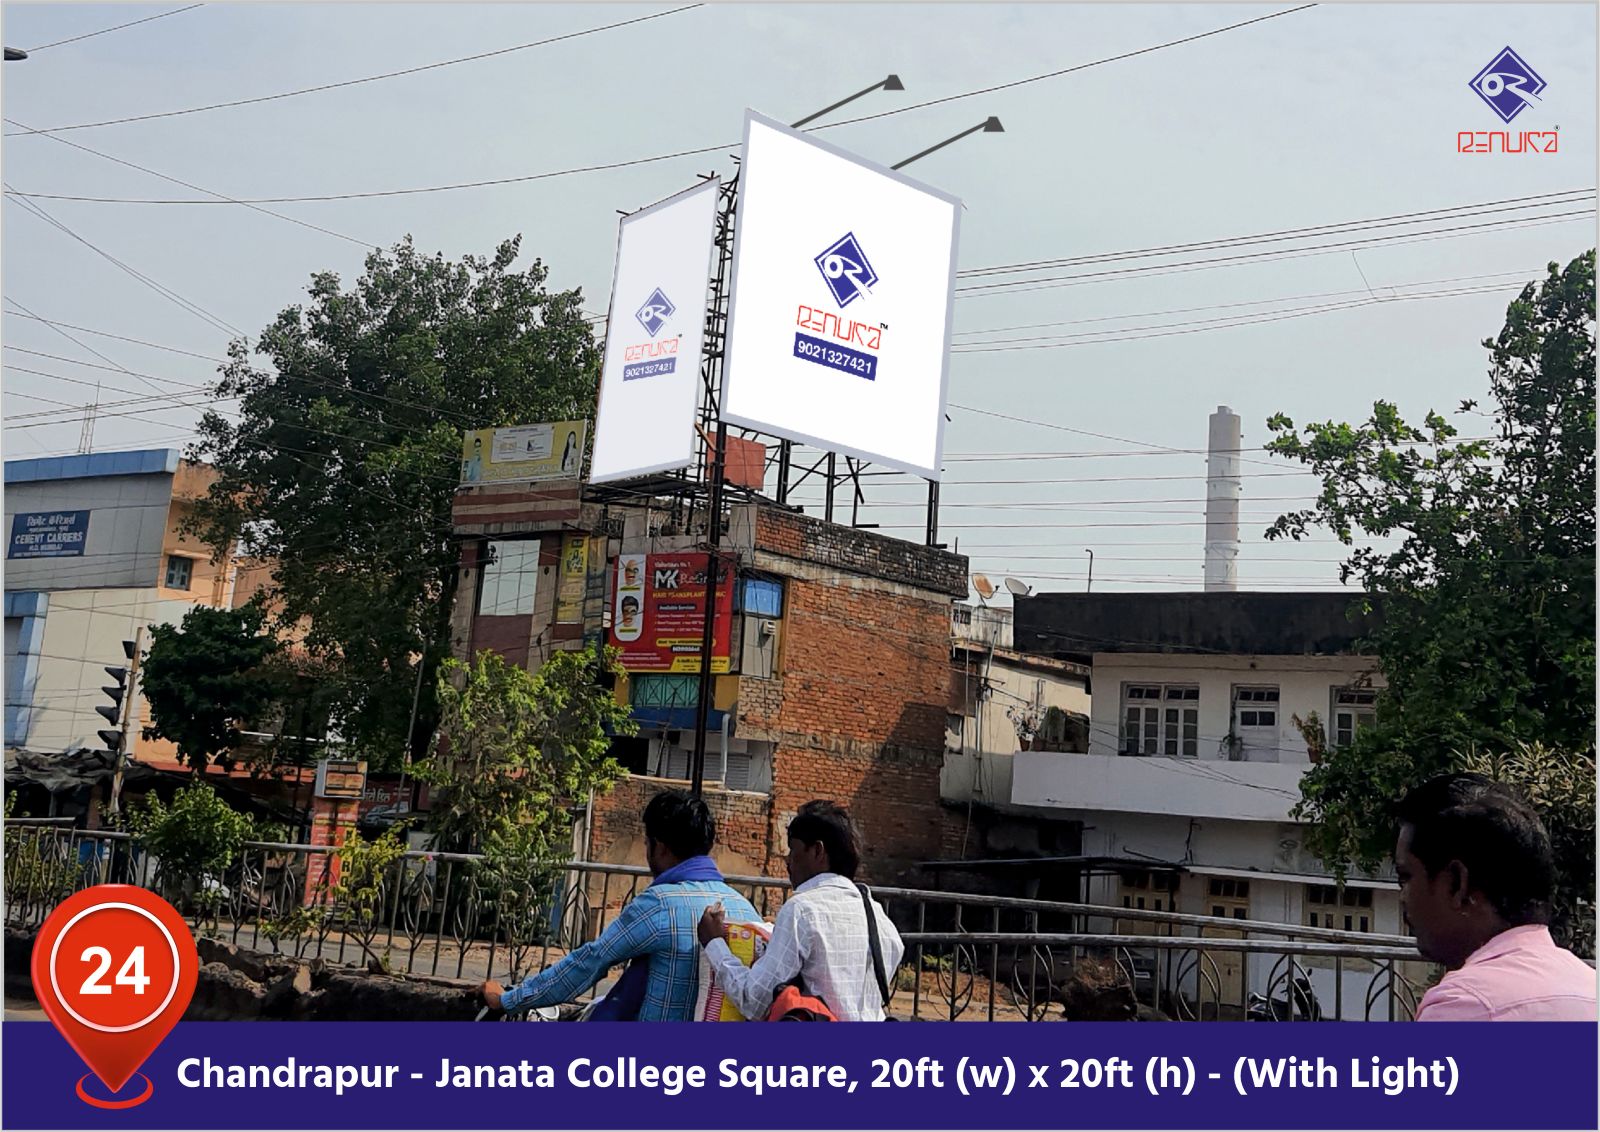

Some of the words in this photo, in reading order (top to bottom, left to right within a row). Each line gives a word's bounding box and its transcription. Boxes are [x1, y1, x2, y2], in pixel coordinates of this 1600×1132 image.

[797, 340, 872, 374] 9021327421
[625, 362, 673, 378] 9021327421
[15, 533, 45, 545] CEMENT
[47, 531, 84, 543] CARRIERS
[655, 569, 679, 589] MK
